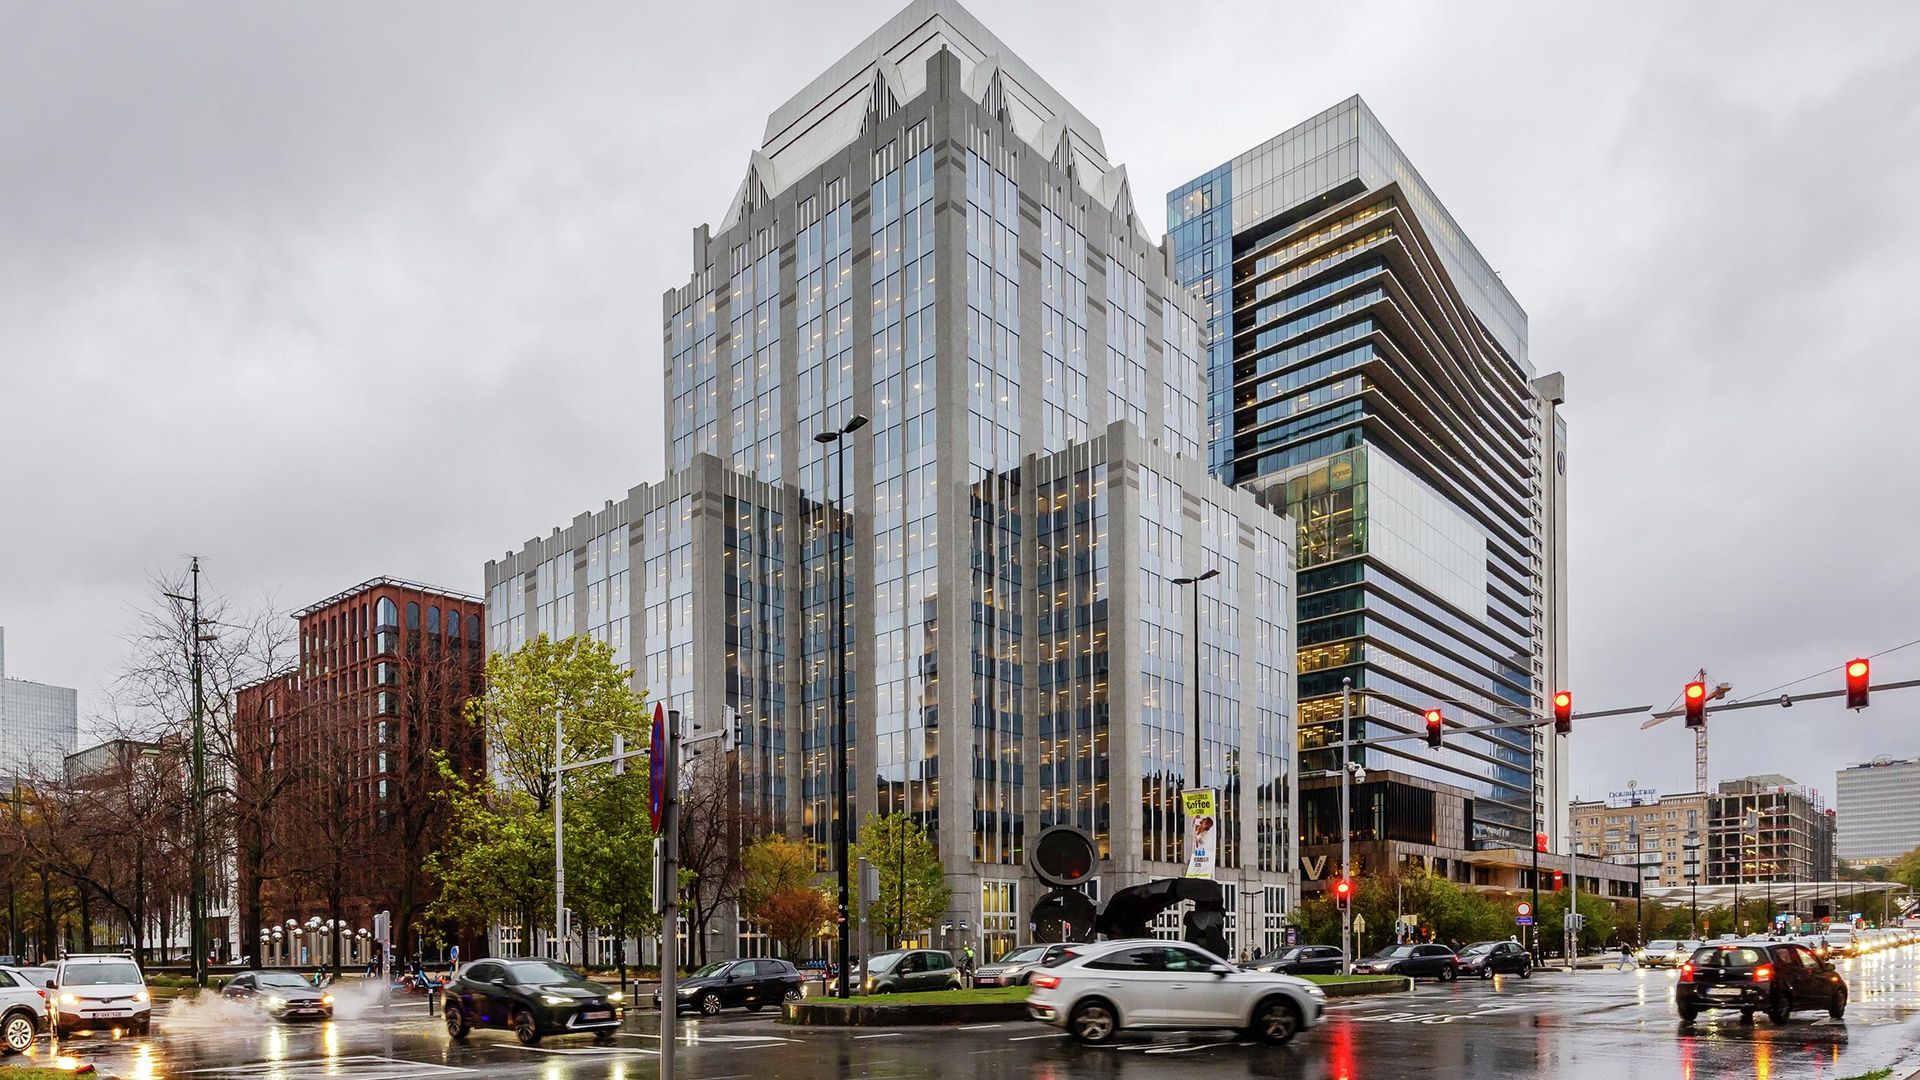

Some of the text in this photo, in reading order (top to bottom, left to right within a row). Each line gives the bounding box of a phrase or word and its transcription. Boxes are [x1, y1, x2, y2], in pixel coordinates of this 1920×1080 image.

[1186, 800, 1210, 810] Coffee
[1301, 856, 1327, 880] V
[1351, 1012, 1476, 1024] BUS
